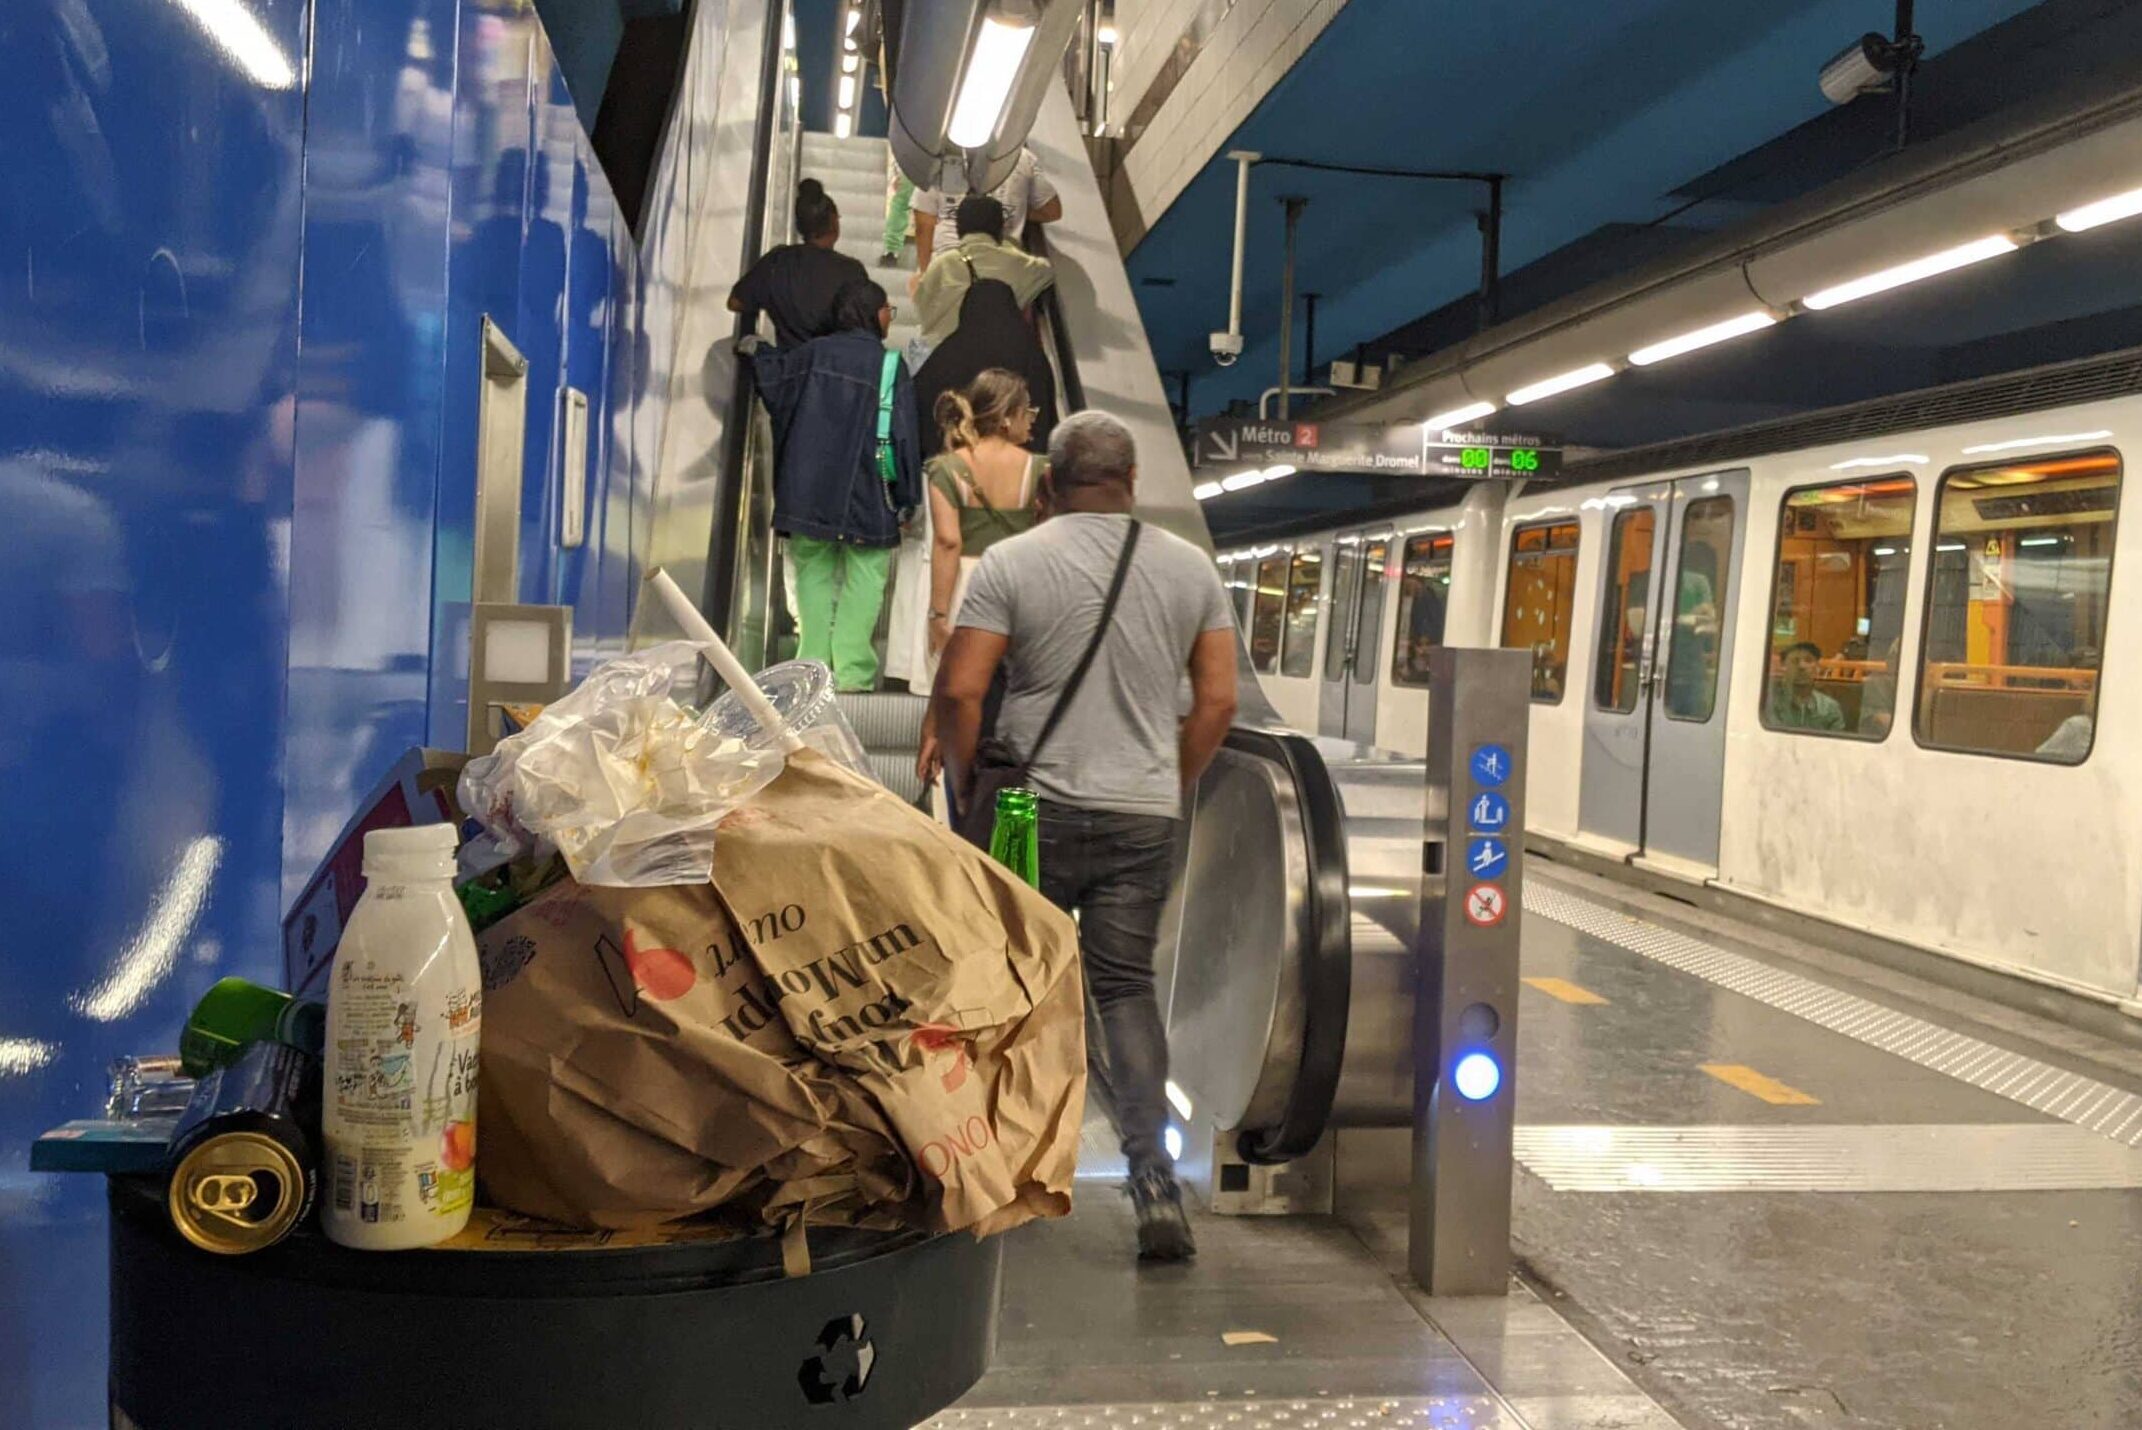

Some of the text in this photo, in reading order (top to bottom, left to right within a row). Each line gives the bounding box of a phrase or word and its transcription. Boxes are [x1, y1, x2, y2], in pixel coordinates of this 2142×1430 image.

[1241, 425, 1313, 445] Métro 2
[1442, 430, 1541, 447] Prochains métros
[1265, 449, 1306, 464] Sainte
[1307, 452, 1373, 469] Marguerite
[1375, 454, 1419, 470] Dromel
[1461, 448, 1489, 468] 00
[1511, 450, 1539, 471] 06
[854, 924, 926, 969] un
